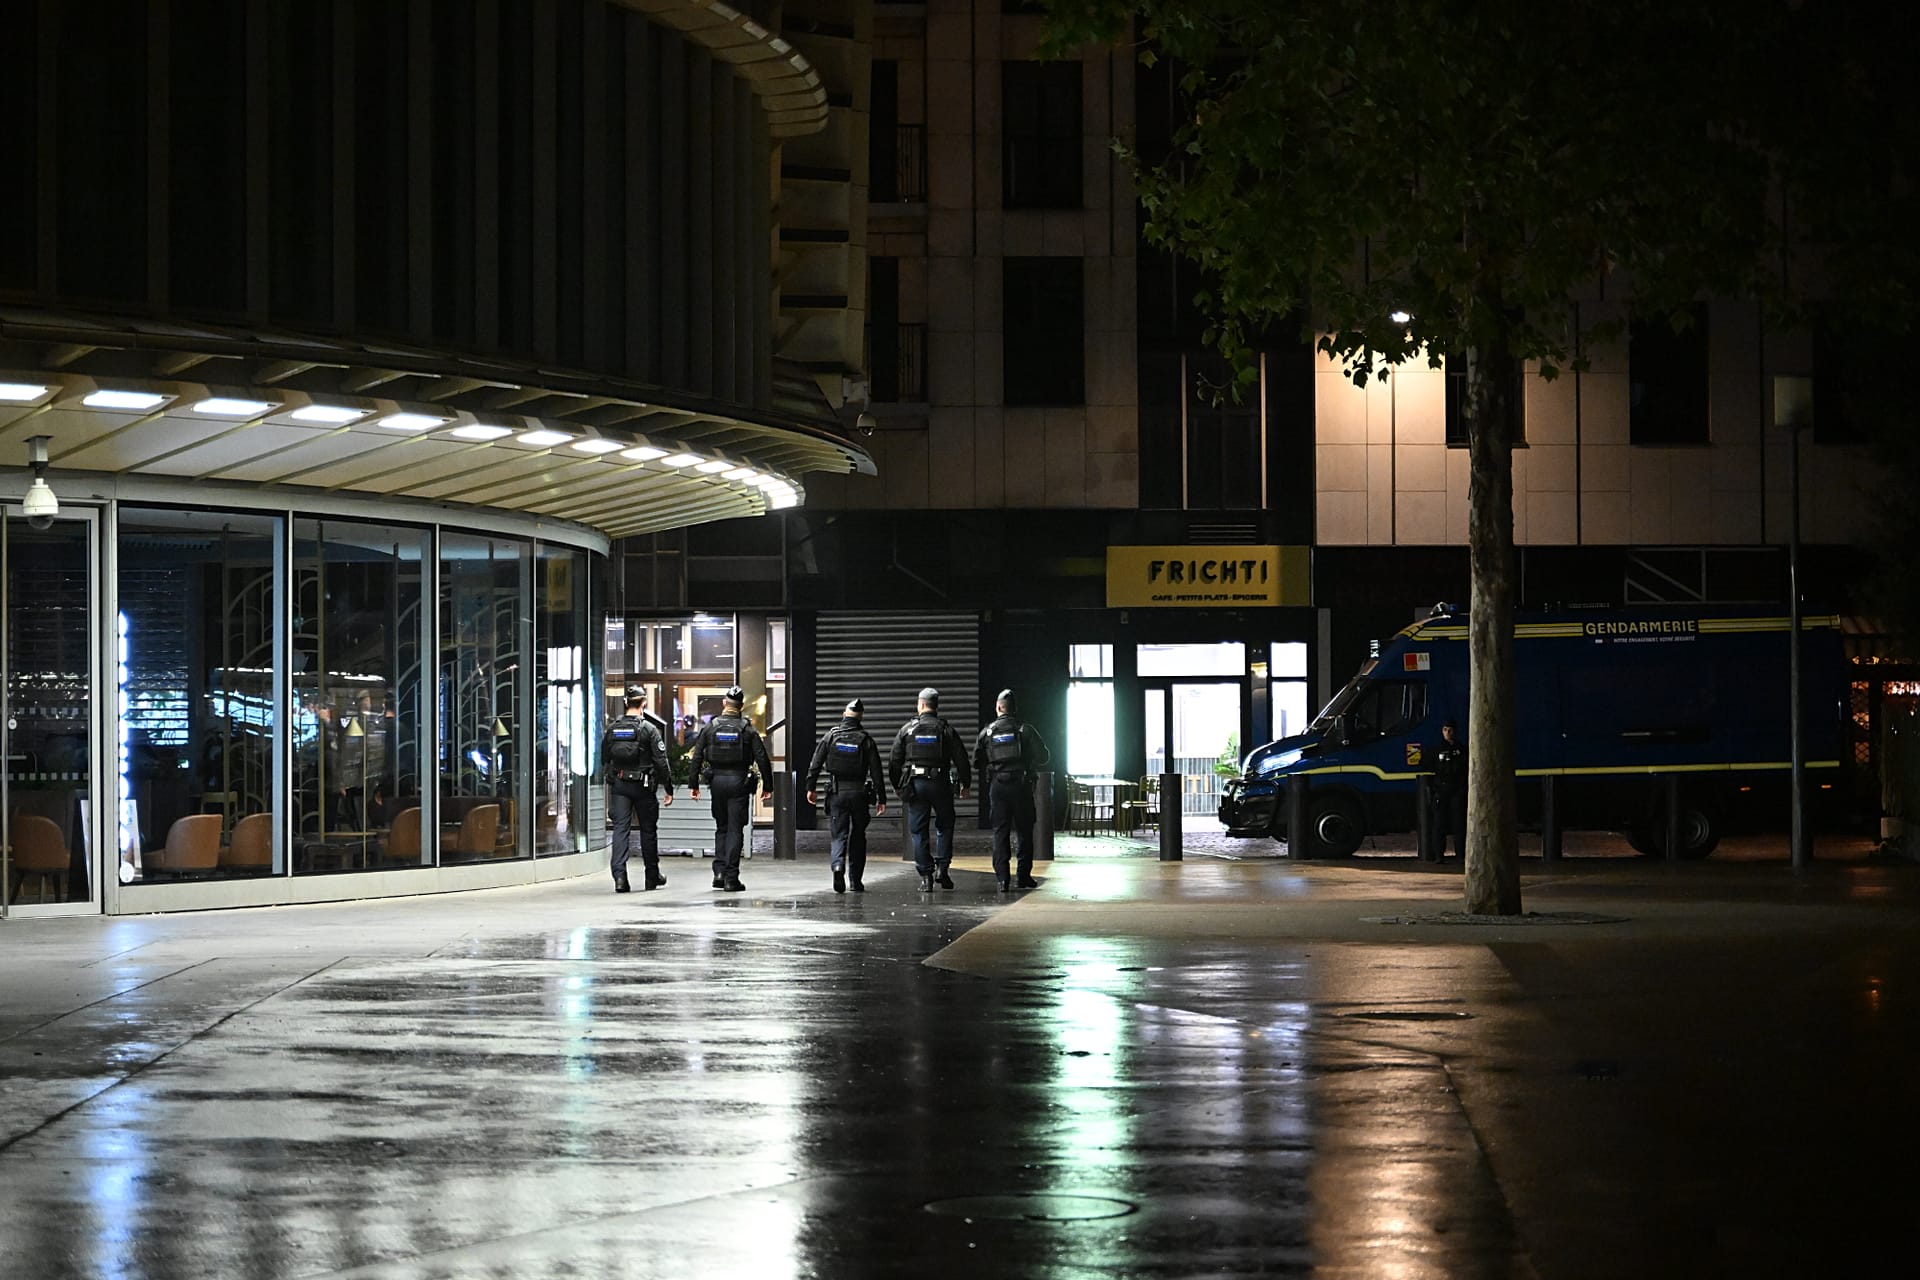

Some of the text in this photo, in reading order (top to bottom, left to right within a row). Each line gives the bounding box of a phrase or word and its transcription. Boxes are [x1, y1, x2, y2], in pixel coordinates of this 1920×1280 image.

[1149, 560, 1268, 584] FRICHTI
[1586, 620, 1696, 635] GENDARMERIE
[1181, 775, 1209, 793] TI
